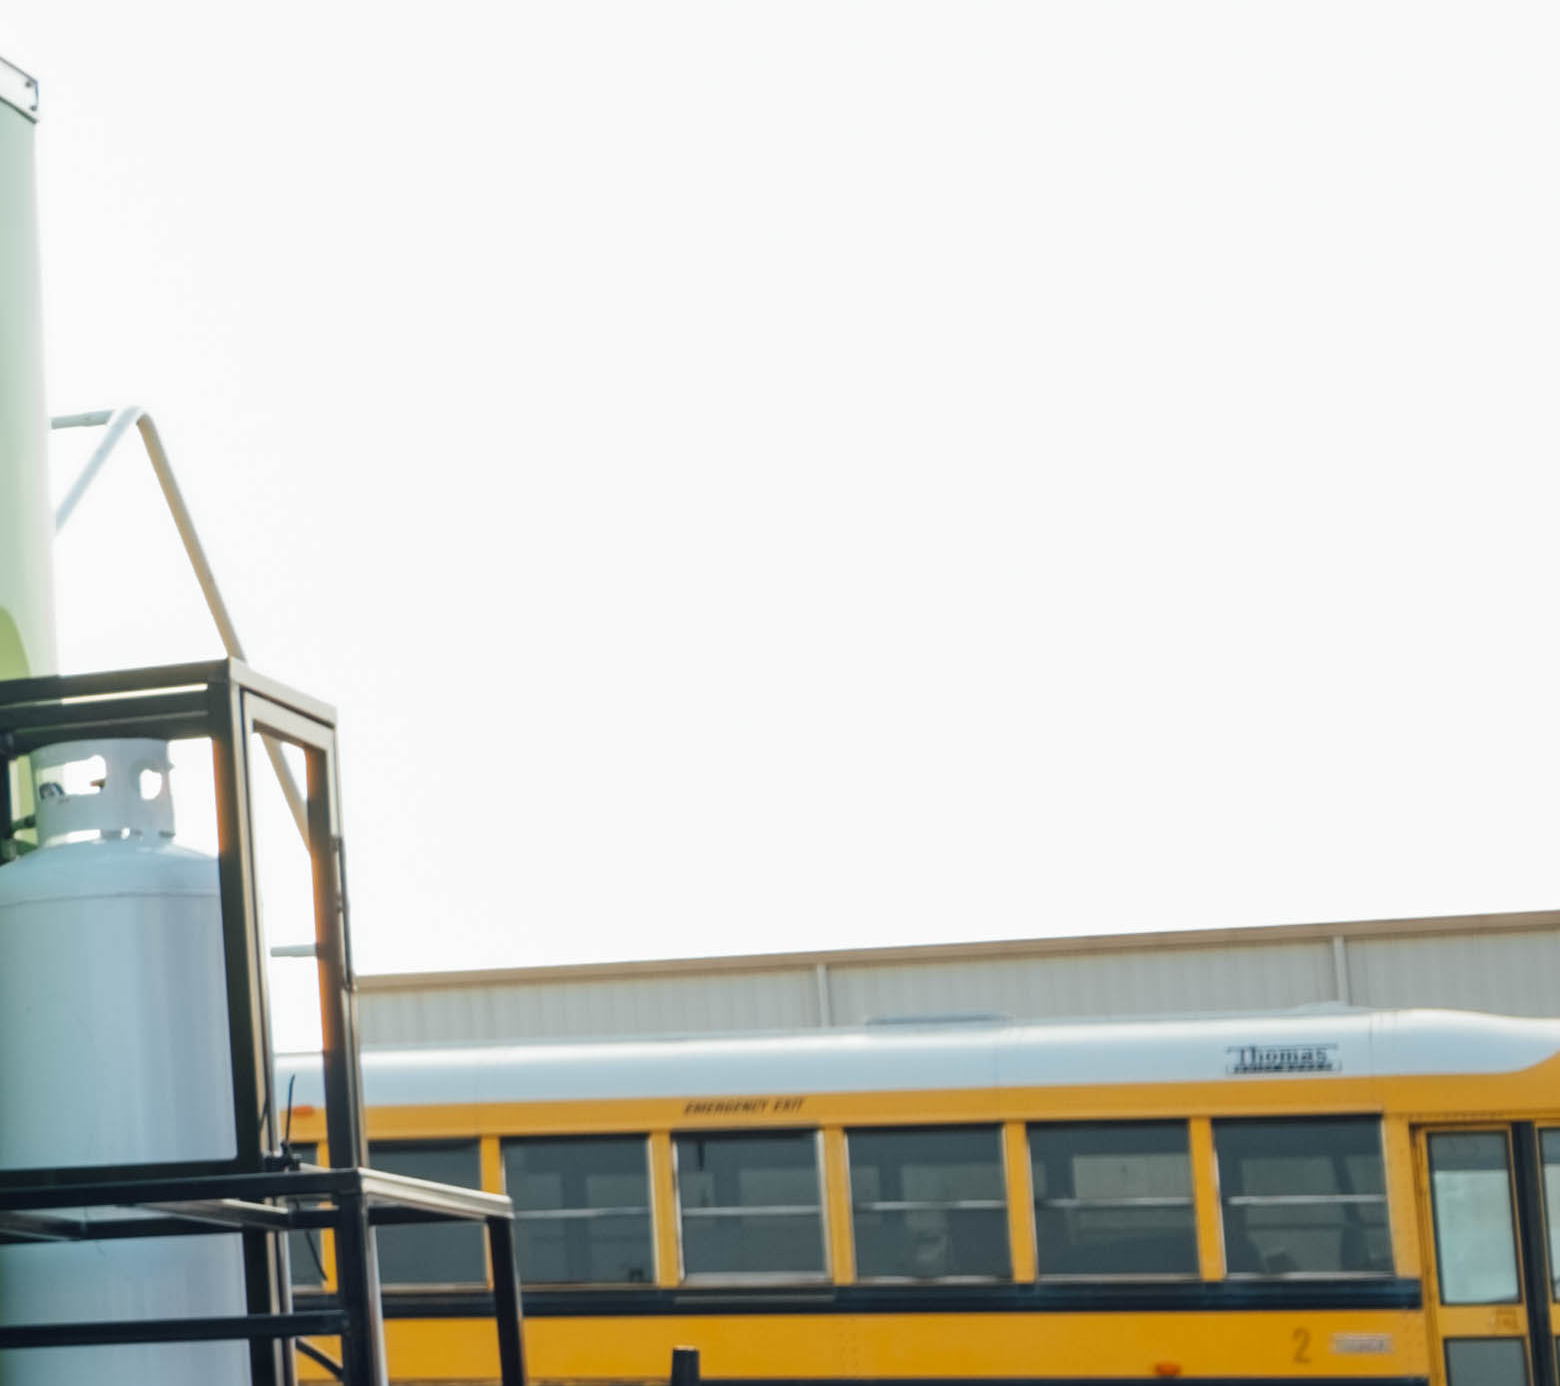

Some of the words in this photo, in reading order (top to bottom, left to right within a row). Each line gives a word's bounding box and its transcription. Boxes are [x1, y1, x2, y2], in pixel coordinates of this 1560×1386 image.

[1235, 1045, 1328, 1064] Thomas
[684, 1098, 768, 1115] EMERGENCY
[774, 1096, 805, 1111] EXIT
[1292, 1327, 1311, 1364] 2
